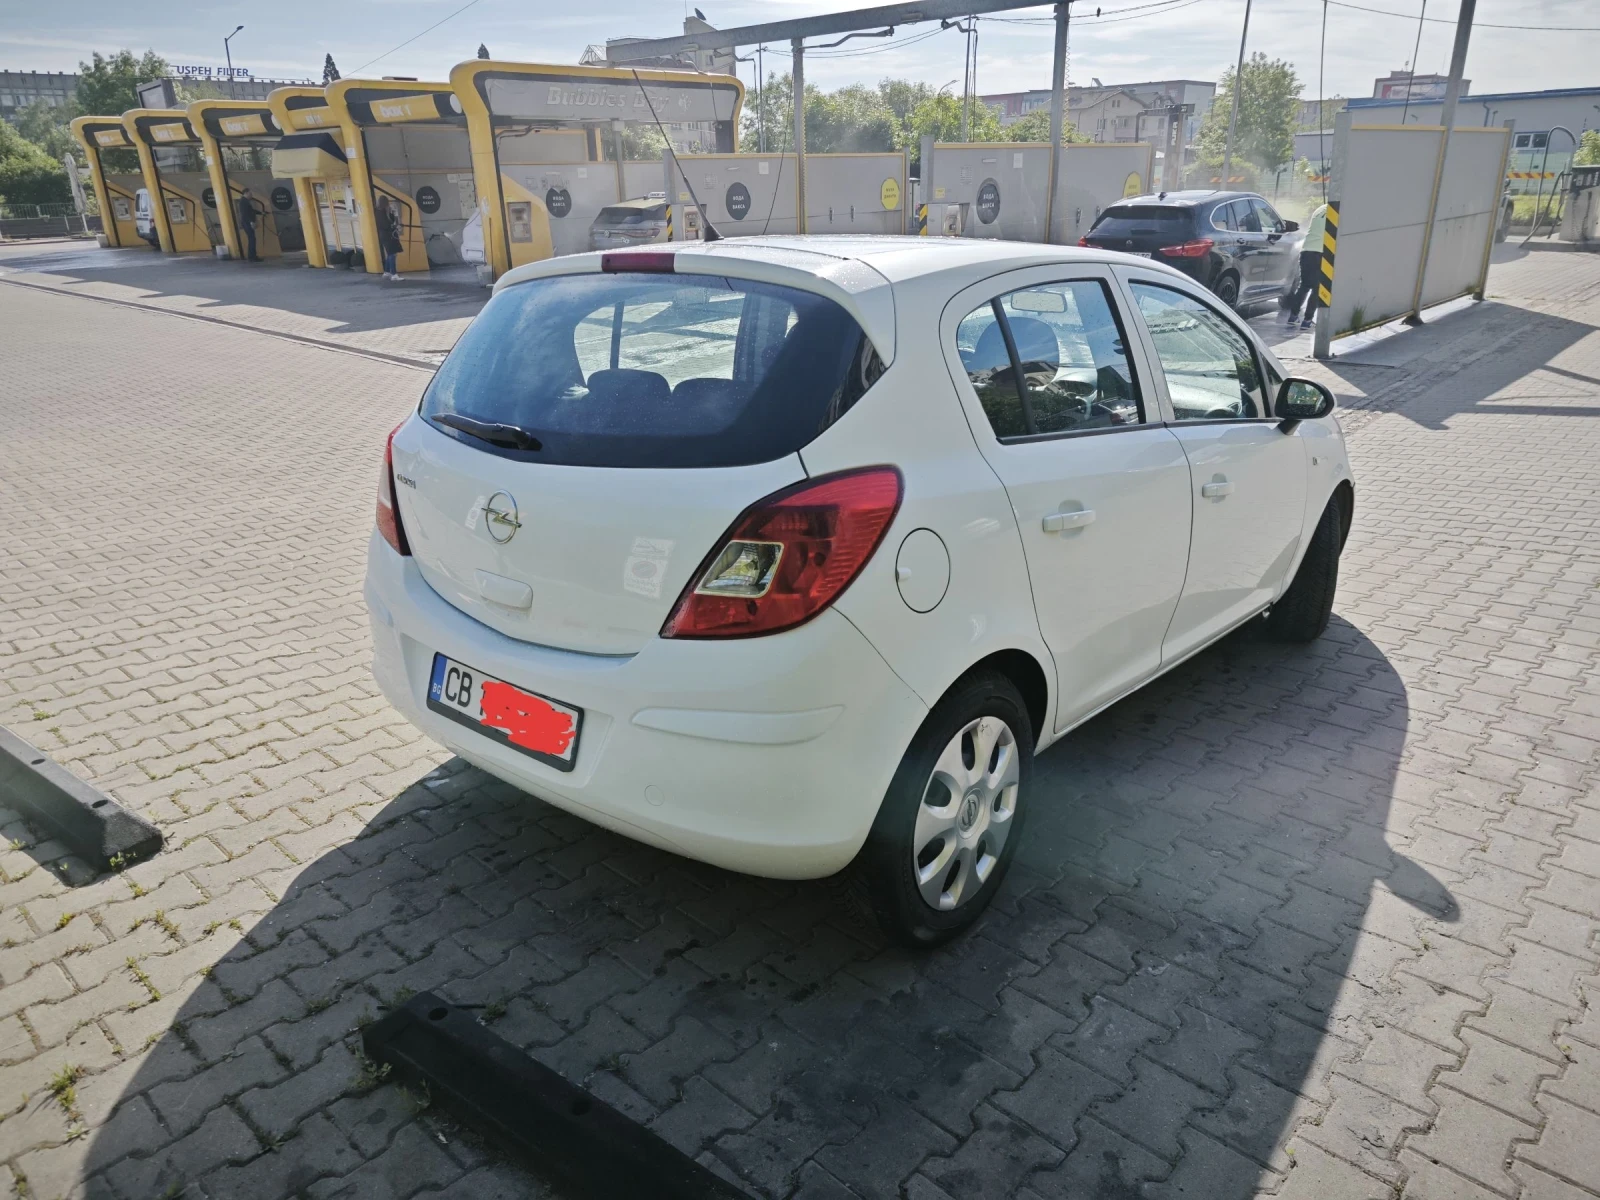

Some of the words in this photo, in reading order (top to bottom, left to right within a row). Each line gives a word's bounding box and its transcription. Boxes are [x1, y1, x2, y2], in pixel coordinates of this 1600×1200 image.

[177, 66, 212, 76] USPEH
[217, 67, 249, 77] FILTER
[546, 87, 626, 107] Bubbles
[432, 682, 442, 695] BG
[445, 666, 473, 708] CB
